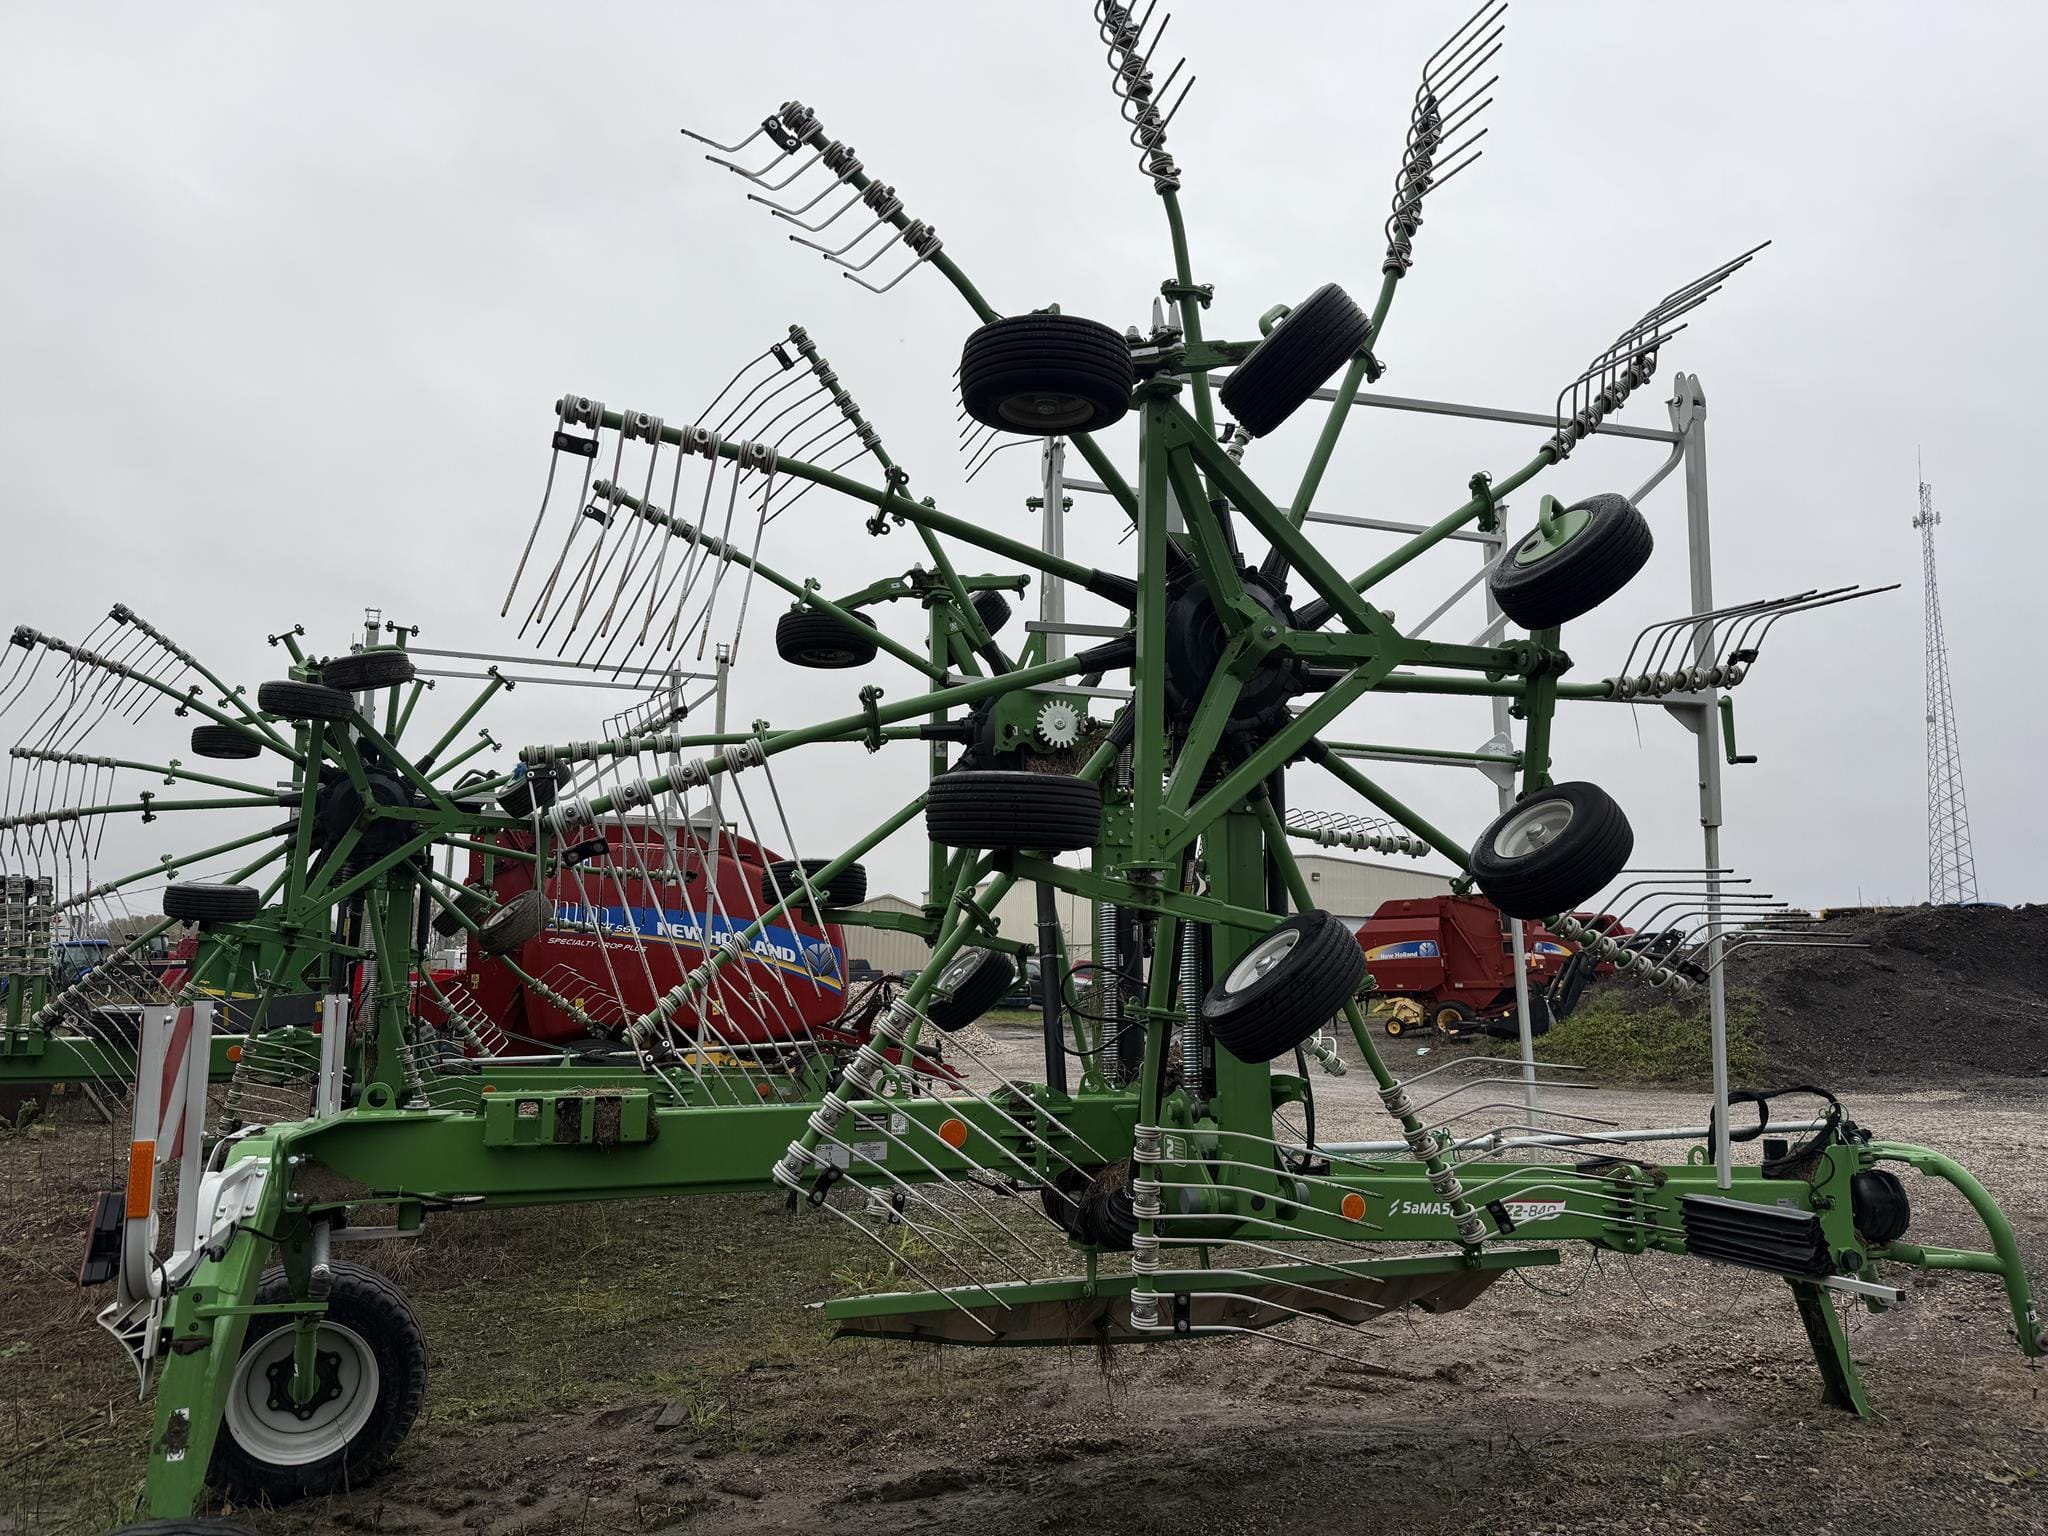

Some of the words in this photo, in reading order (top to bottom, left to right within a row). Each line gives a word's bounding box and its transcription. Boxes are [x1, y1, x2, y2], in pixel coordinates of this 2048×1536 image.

[547, 937, 598, 948] SPECIALTY
[656, 921, 703, 942] NEW
[709, 929, 797, 963] HOAND
[1394, 950, 1418, 960] Holland
[1401, 1201, 1454, 1216] SaMAS
